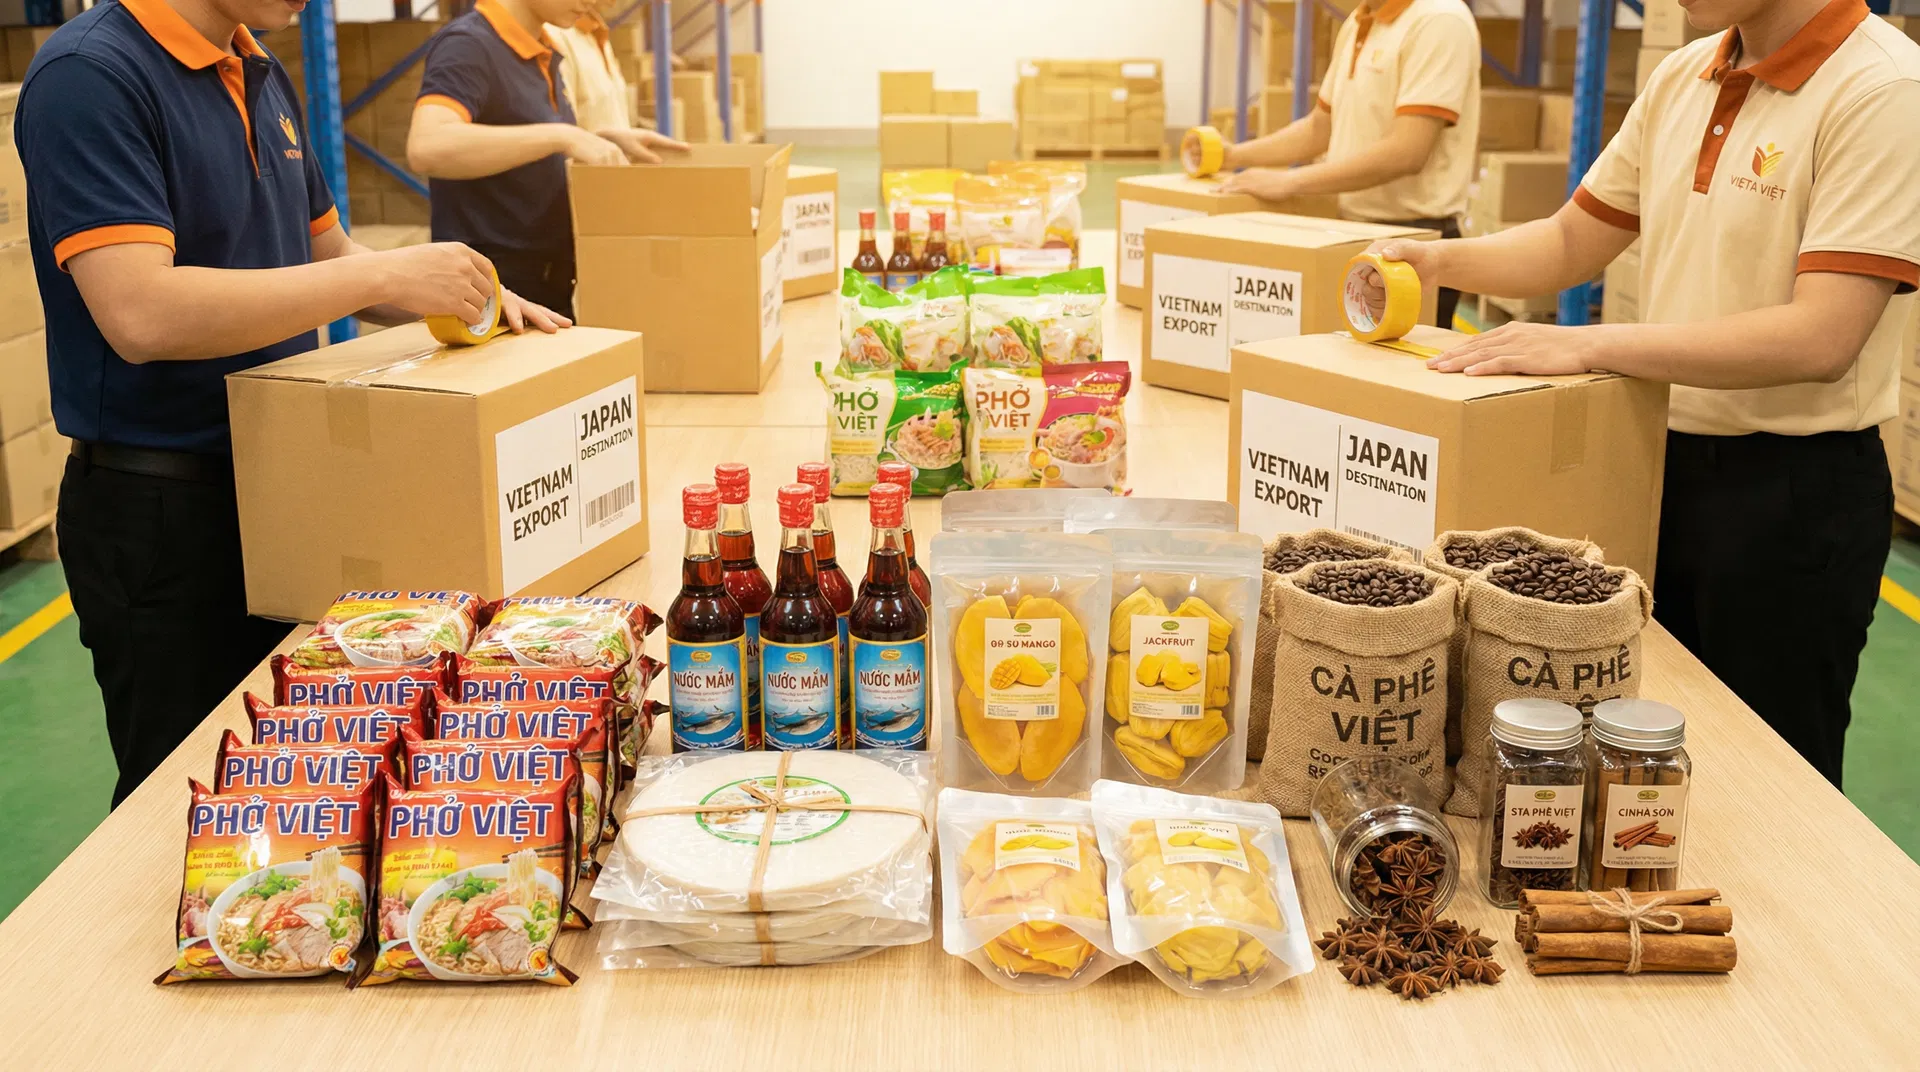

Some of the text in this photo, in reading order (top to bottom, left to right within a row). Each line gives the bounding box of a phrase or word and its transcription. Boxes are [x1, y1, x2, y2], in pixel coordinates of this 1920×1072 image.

[1158, 294, 1222, 317] VIETNAM
[1233, 276, 1293, 302] JAPAN
[1163, 316, 1217, 337] EXPORT
[1233, 300, 1294, 316] DESTINATION
[580, 393, 632, 441] JAPAN
[837, 411, 878, 433] VIỆT
[580, 427, 633, 461] DESTINATION
[1346, 434, 1428, 481] JAPAN
[505, 463, 573, 513] VIETNAM
[1248, 448, 1330, 493] VIETNAM
[1345, 468, 1426, 503] DESTINATION
[1254, 479, 1323, 518] EXPORT
[513, 495, 569, 542] EXPORT
[1021, 640, 1056, 648] MANGO
[1143, 637, 1195, 647] JACKFRUIT
[673, 667, 735, 689] NƯỚC MẮM
[767, 667, 829, 690] NƯỚC MẮM
[859, 664, 921, 687] NƯỚC MẮM
[1310, 656, 1436, 705] CÀ PHÊ
[1506, 643, 1632, 691] CÀ PHÊ
[1331, 708, 1422, 752] VIỆT
[224, 747, 384, 790] PHỞ VIỆT
[413, 743, 569, 786] PHỞ VIỆT
[192, 793, 358, 841] PHỞ VIỆT
[389, 795, 554, 842] PHỞ VIỆT
[1511, 807, 1530, 817] STA
